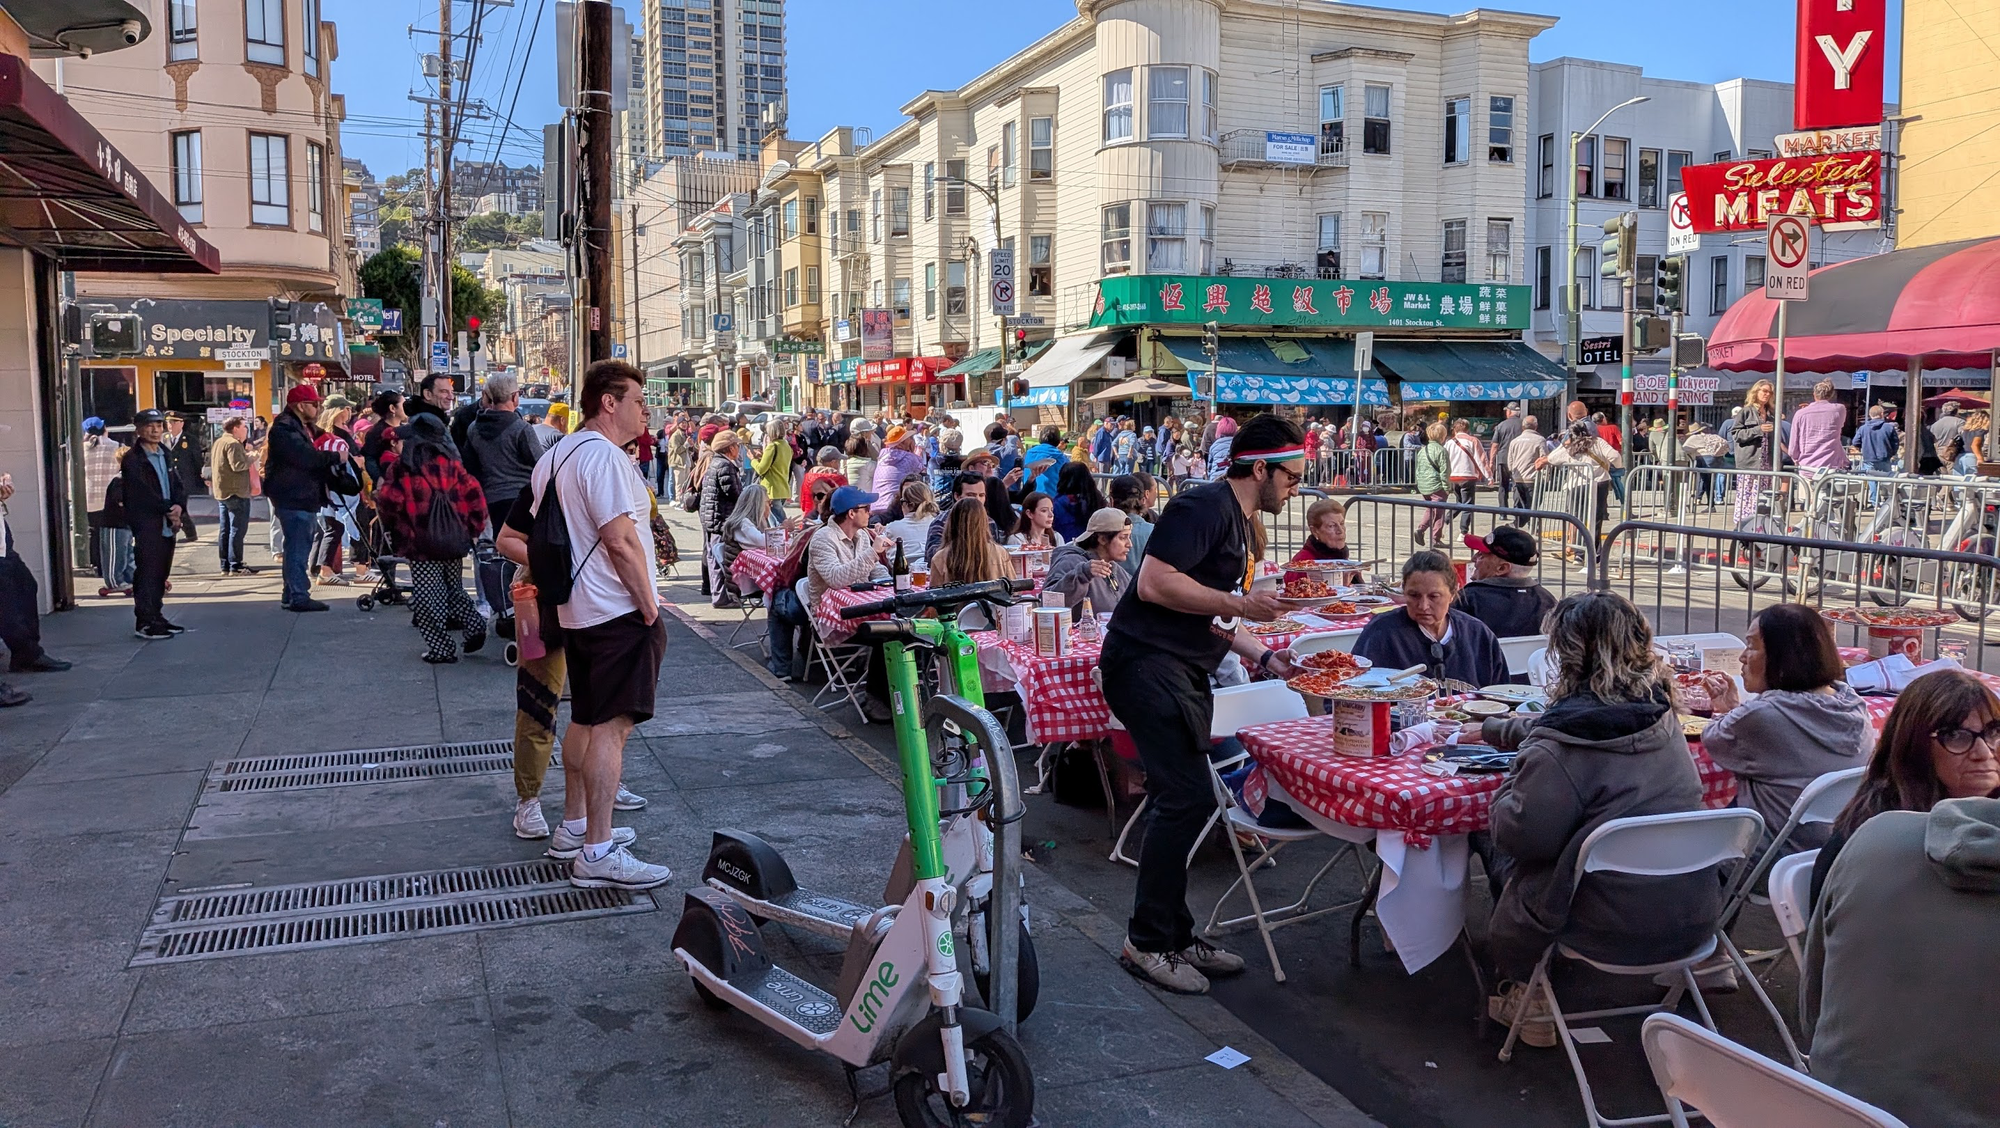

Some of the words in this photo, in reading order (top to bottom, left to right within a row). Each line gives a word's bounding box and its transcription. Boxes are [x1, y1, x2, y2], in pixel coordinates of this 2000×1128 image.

[1784, 131, 1879, 153] MARKET
[1723, 155, 1873, 190] Selected
[1715, 182, 1873, 227] MEATS
[1670, 236, 1681, 247] ON
[1682, 234, 1697, 244] RED
[994, 265, 1011, 276] 20
[1769, 276, 1783, 289] ON
[1786, 277, 1805, 290] RED
[1159, 282, 1393, 316] 恆興超級市場
[1403, 301, 1431, 309] Market
[1439, 294, 1474, 316] 農場
[1405, 319, 1434, 327] Stockton
[1436, 319, 1445, 327] St.
[151, 323, 256, 345] Specialty
[1583, 339, 1611, 350] Sestri
[221, 350, 262, 359] STOCKTON
[1579, 350, 1621, 363] OTEL
[1709, 345, 1735, 361] MARKET
[1636, 375, 1667, 389] 杏の屋
[1676, 376, 1719, 391] uckyever
[1662, 392, 1709, 404] OENING
[717, 858, 752, 885] MCJZGK
[766, 979, 805, 1004] Lime
[850, 961, 900, 1034] Lime
